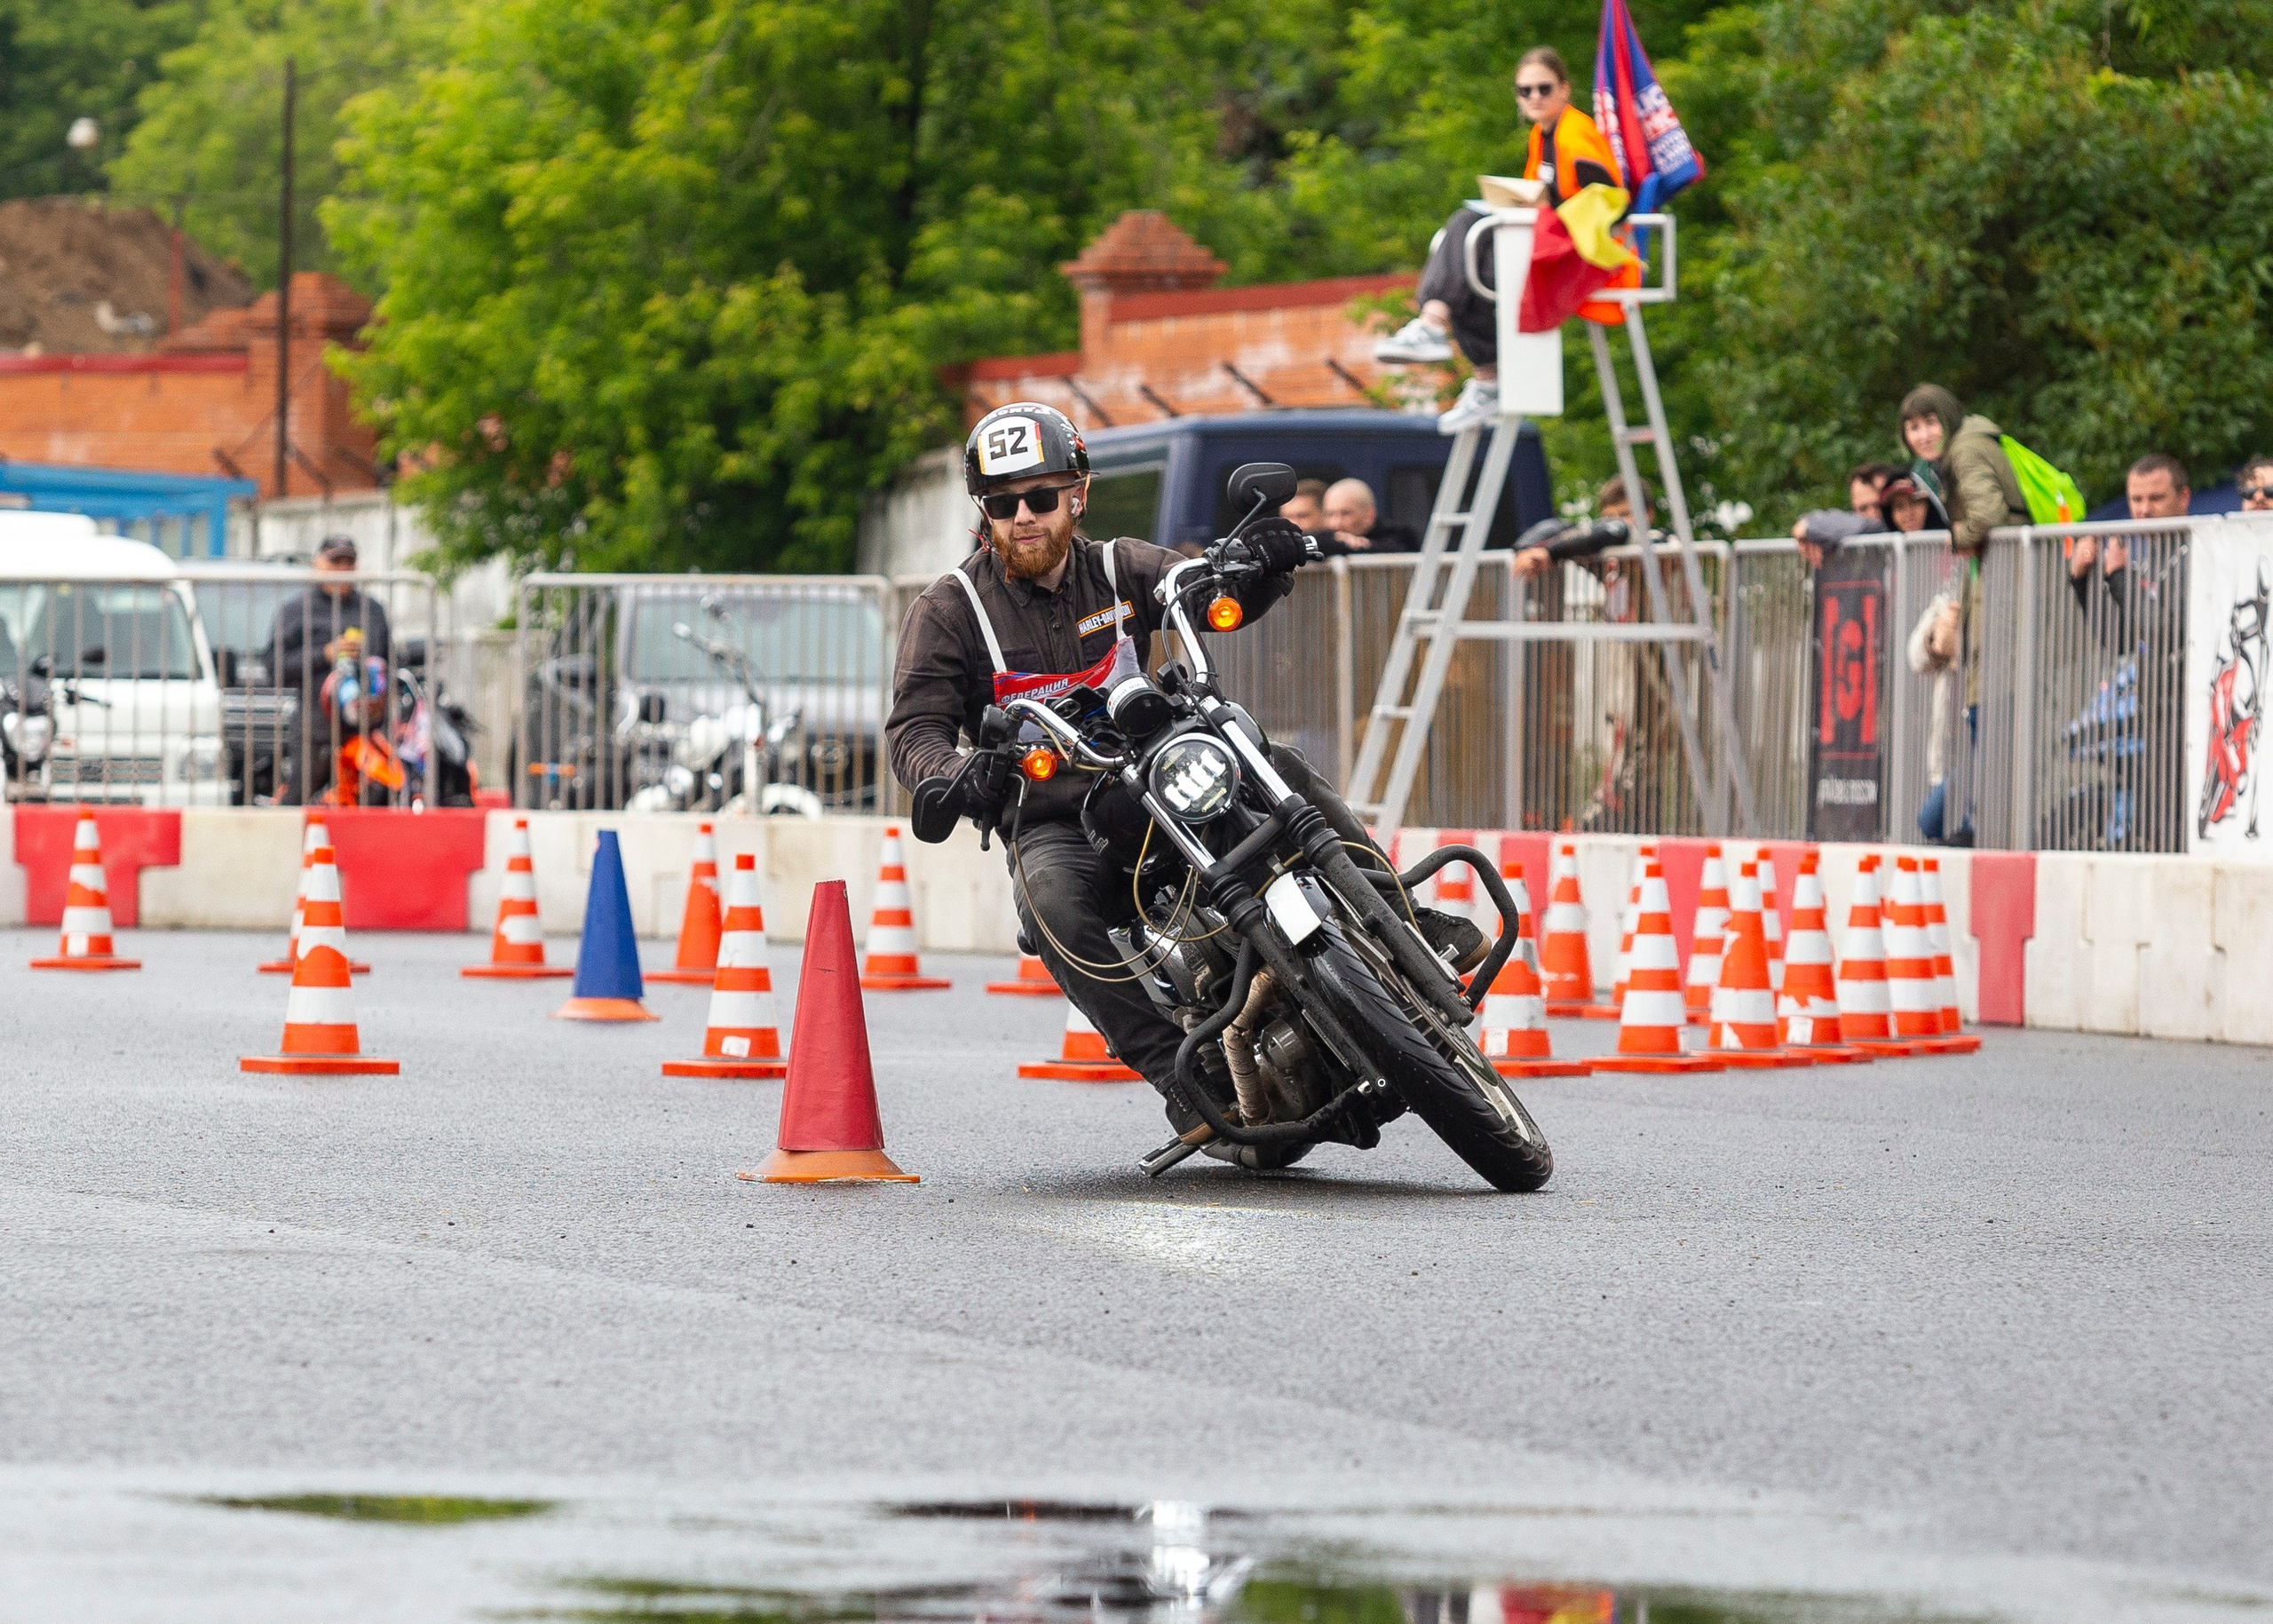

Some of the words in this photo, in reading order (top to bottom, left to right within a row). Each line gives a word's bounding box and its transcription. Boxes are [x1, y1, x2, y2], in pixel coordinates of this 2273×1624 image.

[988, 426, 1028, 460] 52
[1078, 604, 1132, 634] HARLEY-DAVION
[1001, 677, 1069, 703] ФЕДЕРАЦИЯ
